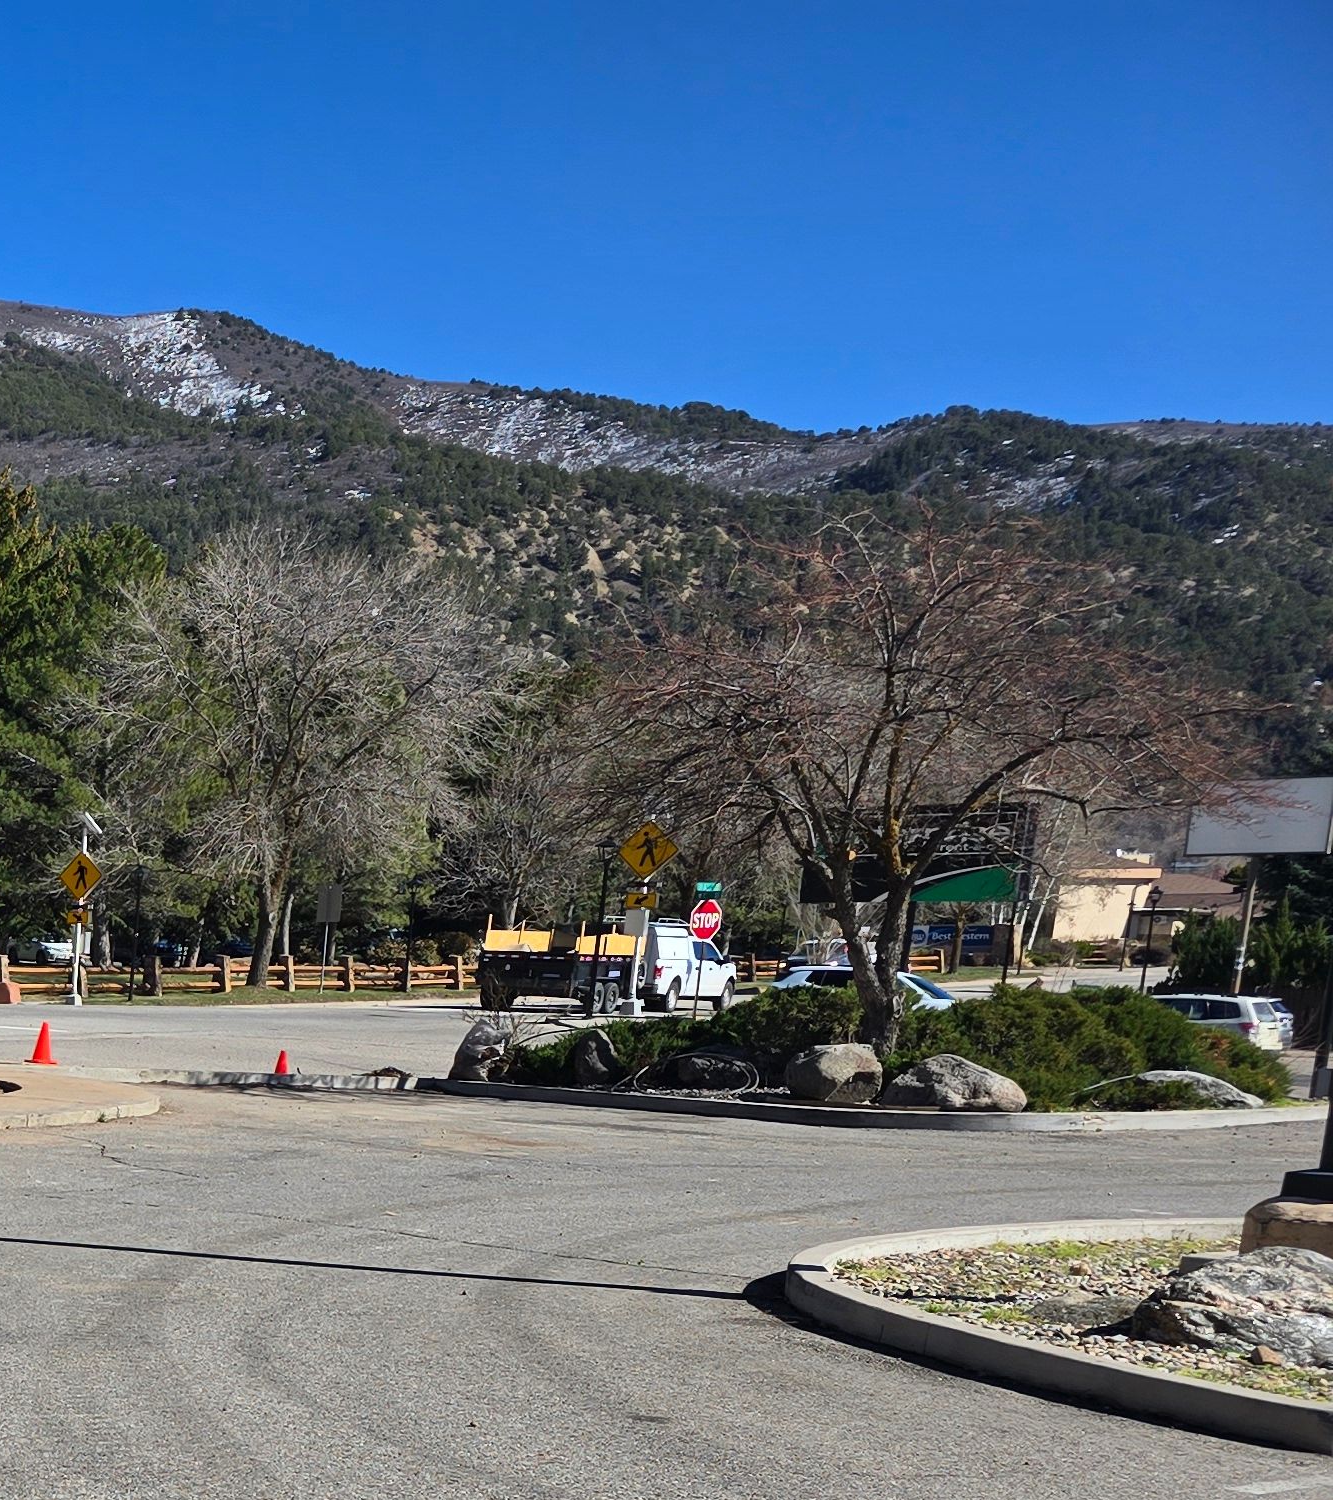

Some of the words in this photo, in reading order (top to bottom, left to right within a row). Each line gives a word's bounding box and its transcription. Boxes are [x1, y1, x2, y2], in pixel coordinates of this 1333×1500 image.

[693, 912, 720, 929] STOP
[931, 931, 951, 940] Best
[955, 932, 990, 940] estern
